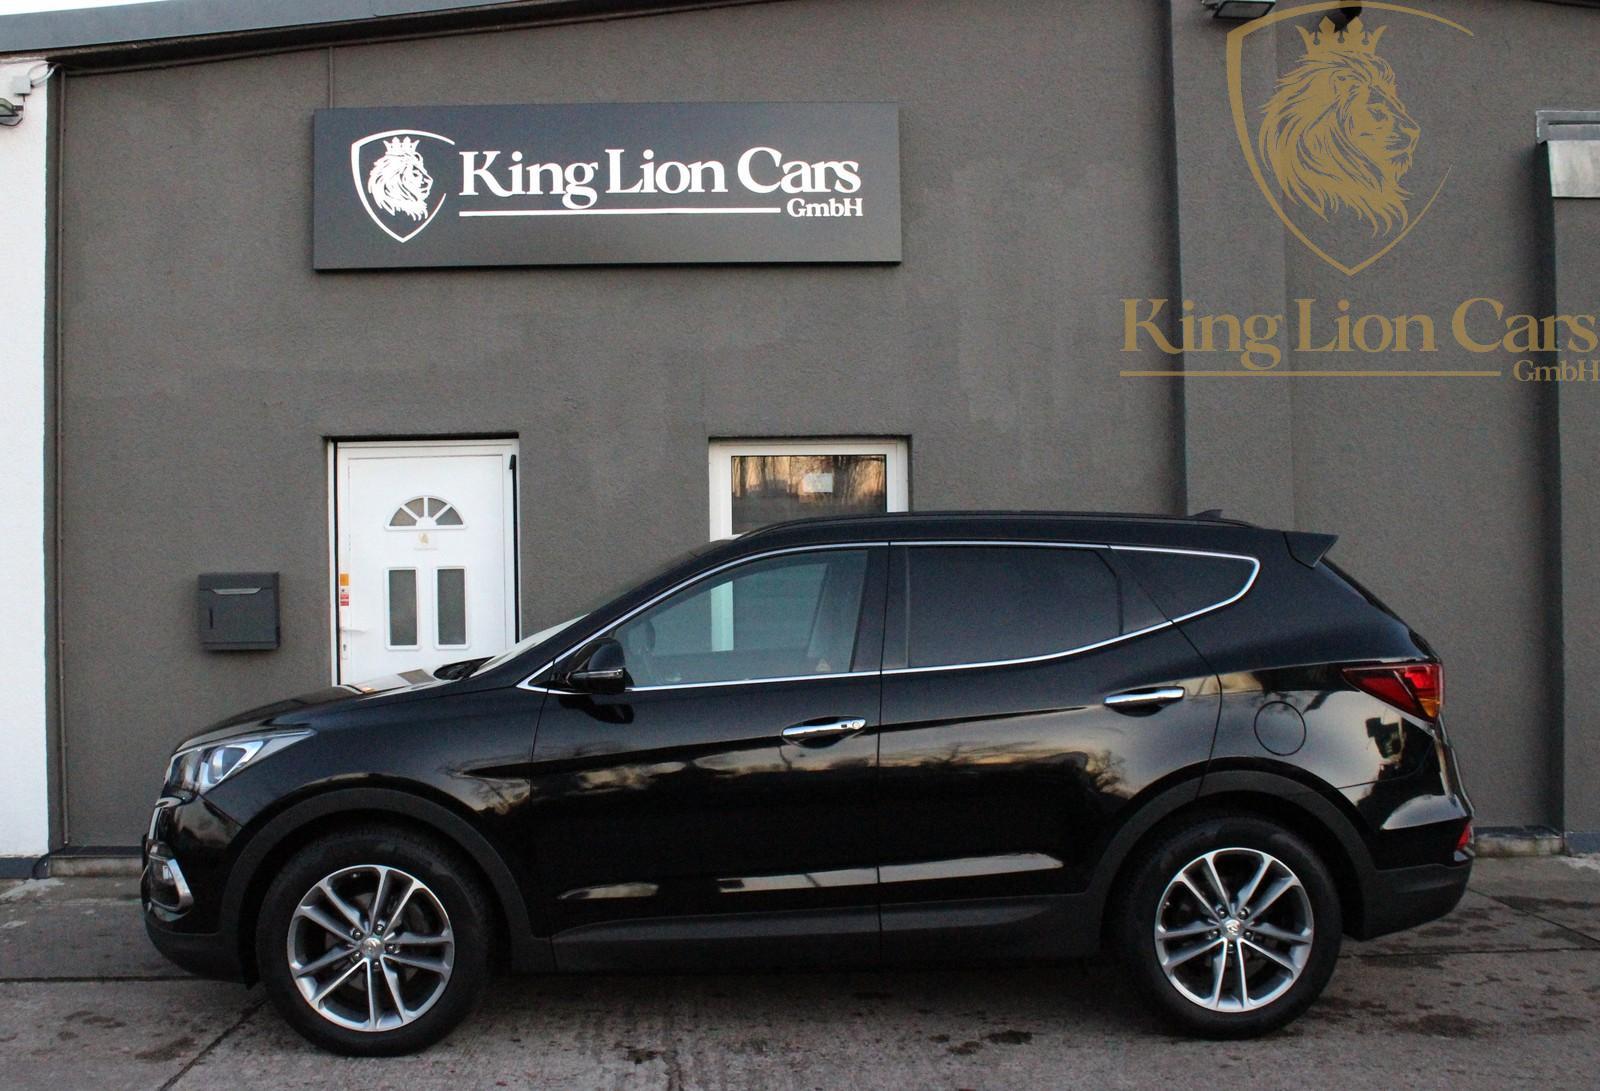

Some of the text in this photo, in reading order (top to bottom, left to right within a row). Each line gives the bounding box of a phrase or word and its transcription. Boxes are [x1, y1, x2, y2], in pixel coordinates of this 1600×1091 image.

[458, 146, 861, 209] King Lion Cars
[786, 197, 864, 218] GmbH
